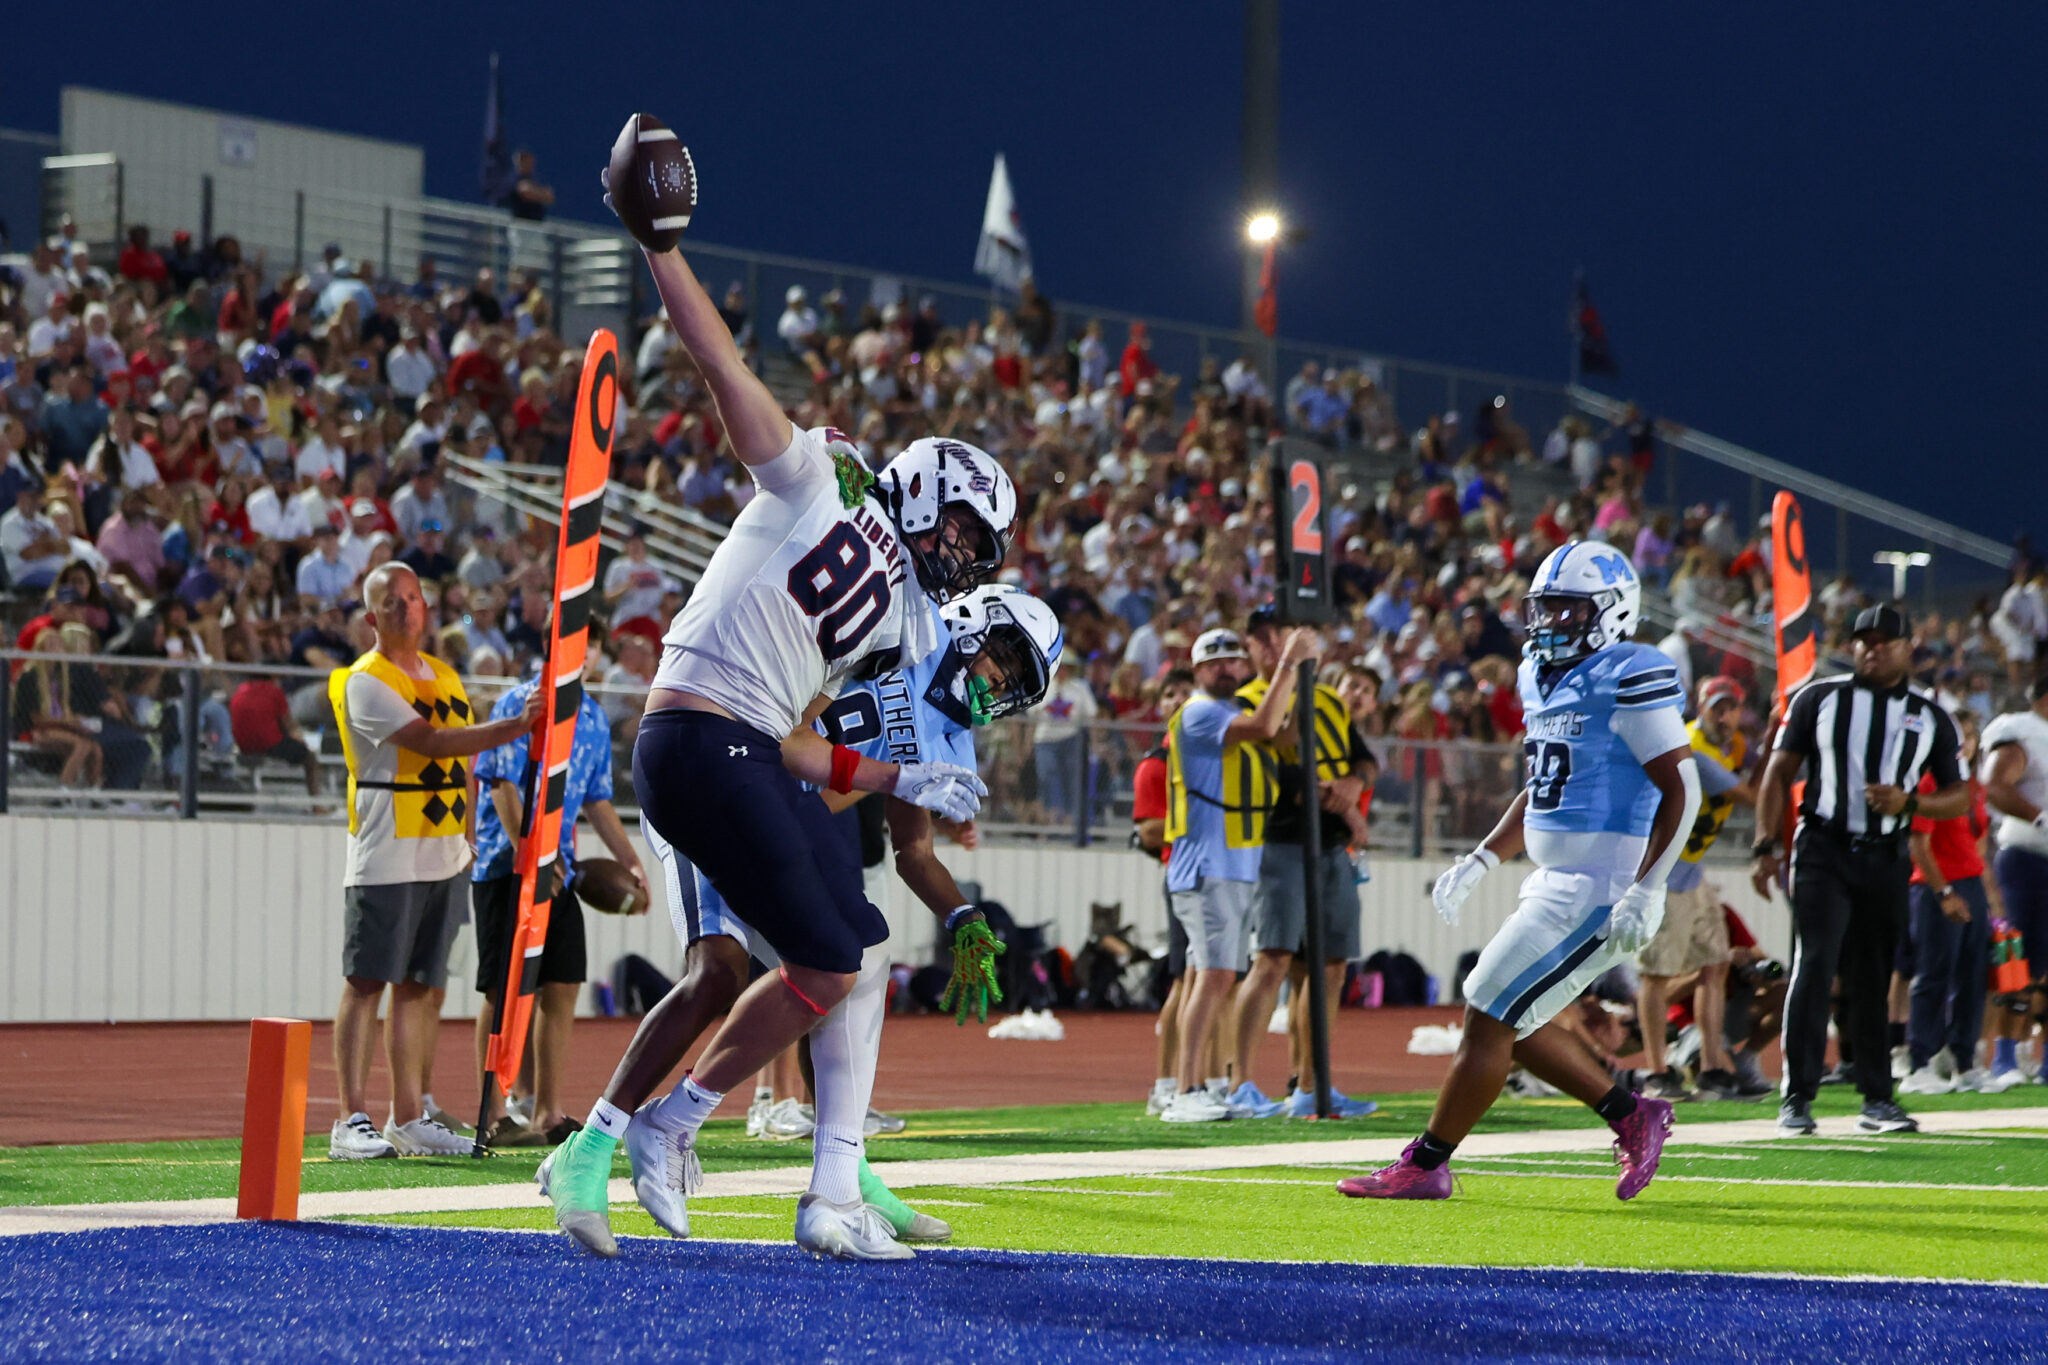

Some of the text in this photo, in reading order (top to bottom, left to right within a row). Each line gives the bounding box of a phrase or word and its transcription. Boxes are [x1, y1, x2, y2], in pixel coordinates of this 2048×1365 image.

[1289, 459, 1323, 556] 2
[786, 518, 892, 662] 80
[1590, 553, 1634, 585] M
